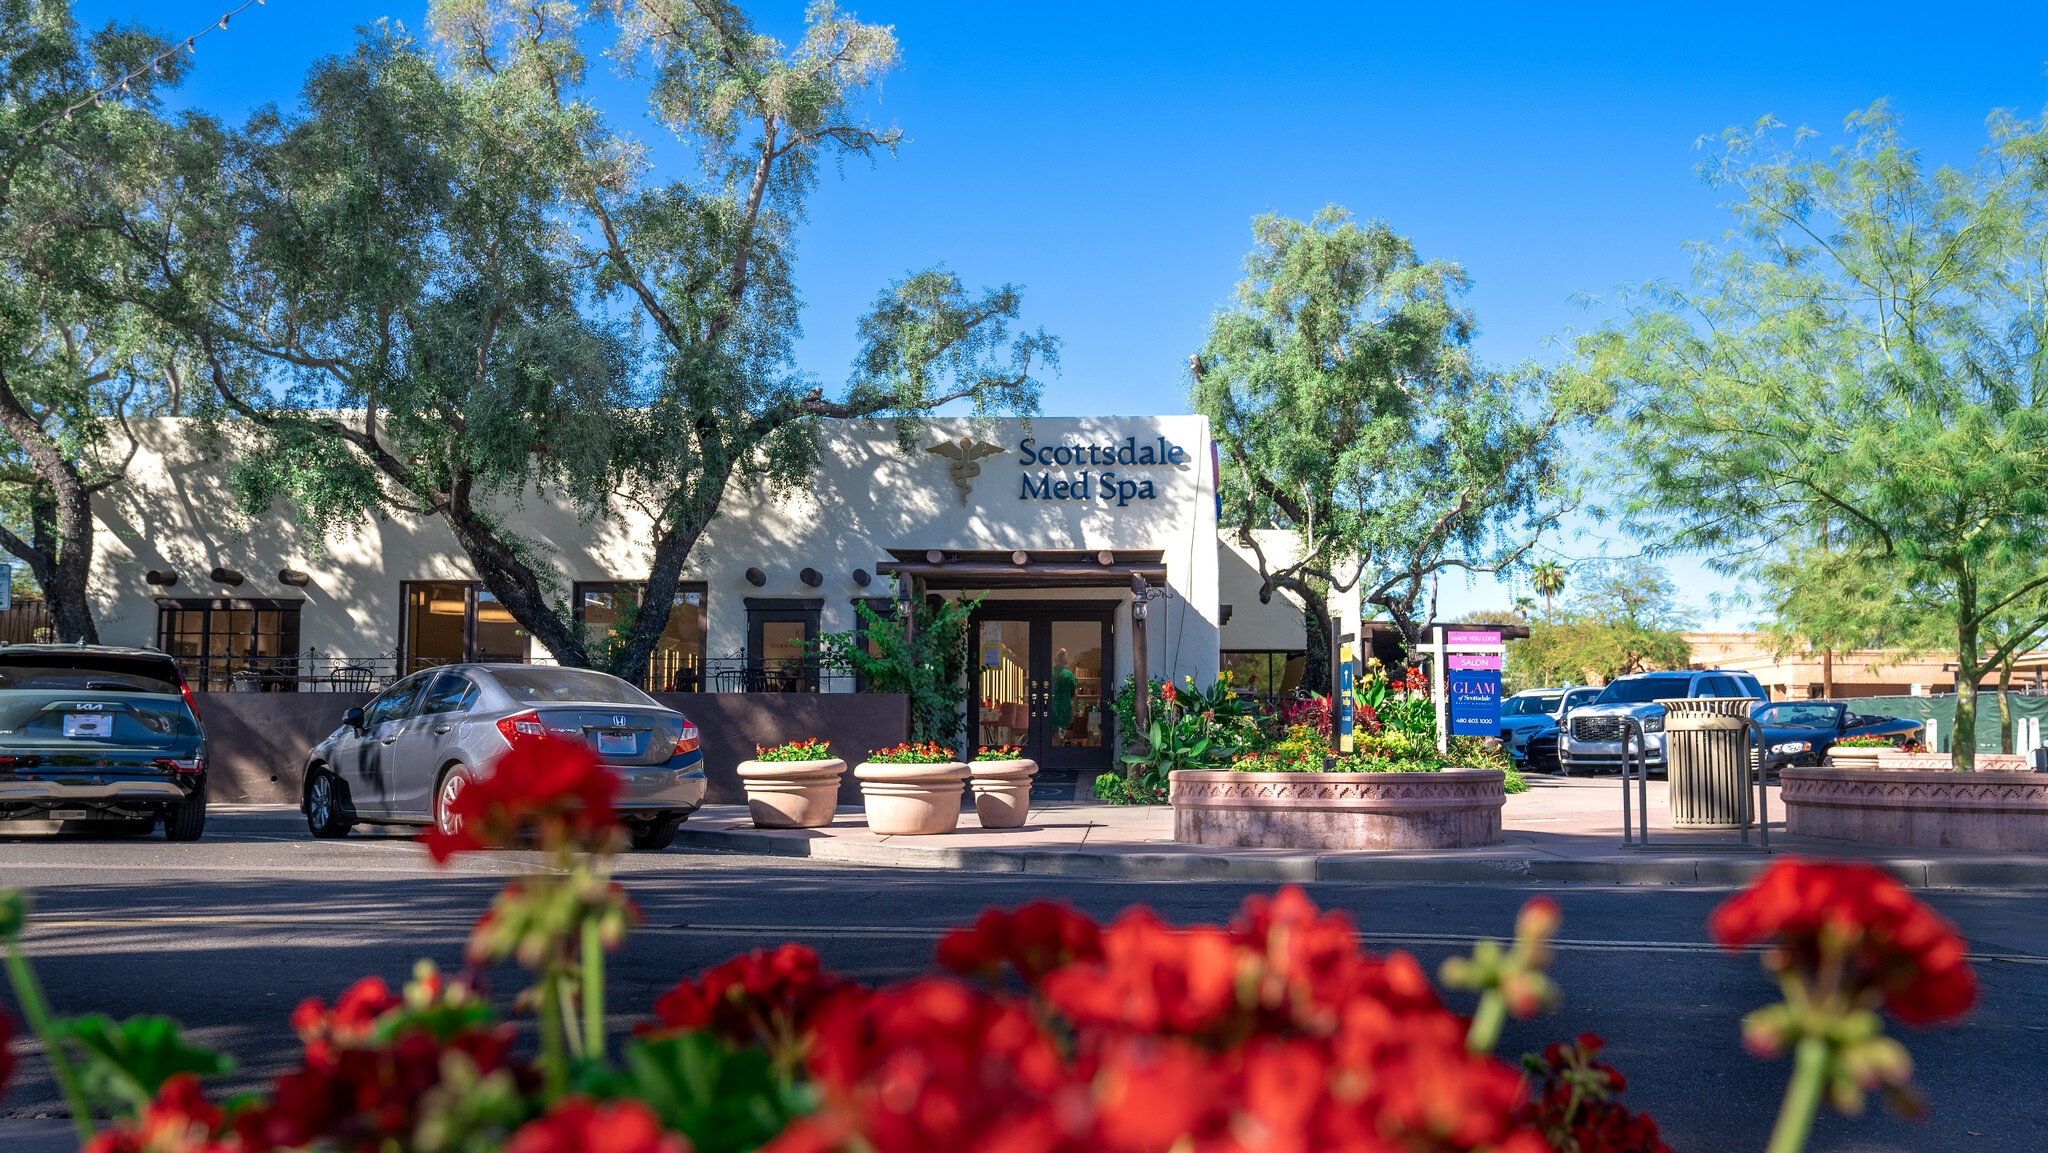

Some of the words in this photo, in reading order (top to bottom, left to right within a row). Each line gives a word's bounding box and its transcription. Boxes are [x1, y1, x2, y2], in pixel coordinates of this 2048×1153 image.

[1019, 436, 1184, 466] Scottsdale
[1019, 471, 1091, 500] Med
[1100, 472, 1157, 507] Spa
[1461, 658, 1489, 667] SALON
[1452, 681, 1495, 695] GLAM
